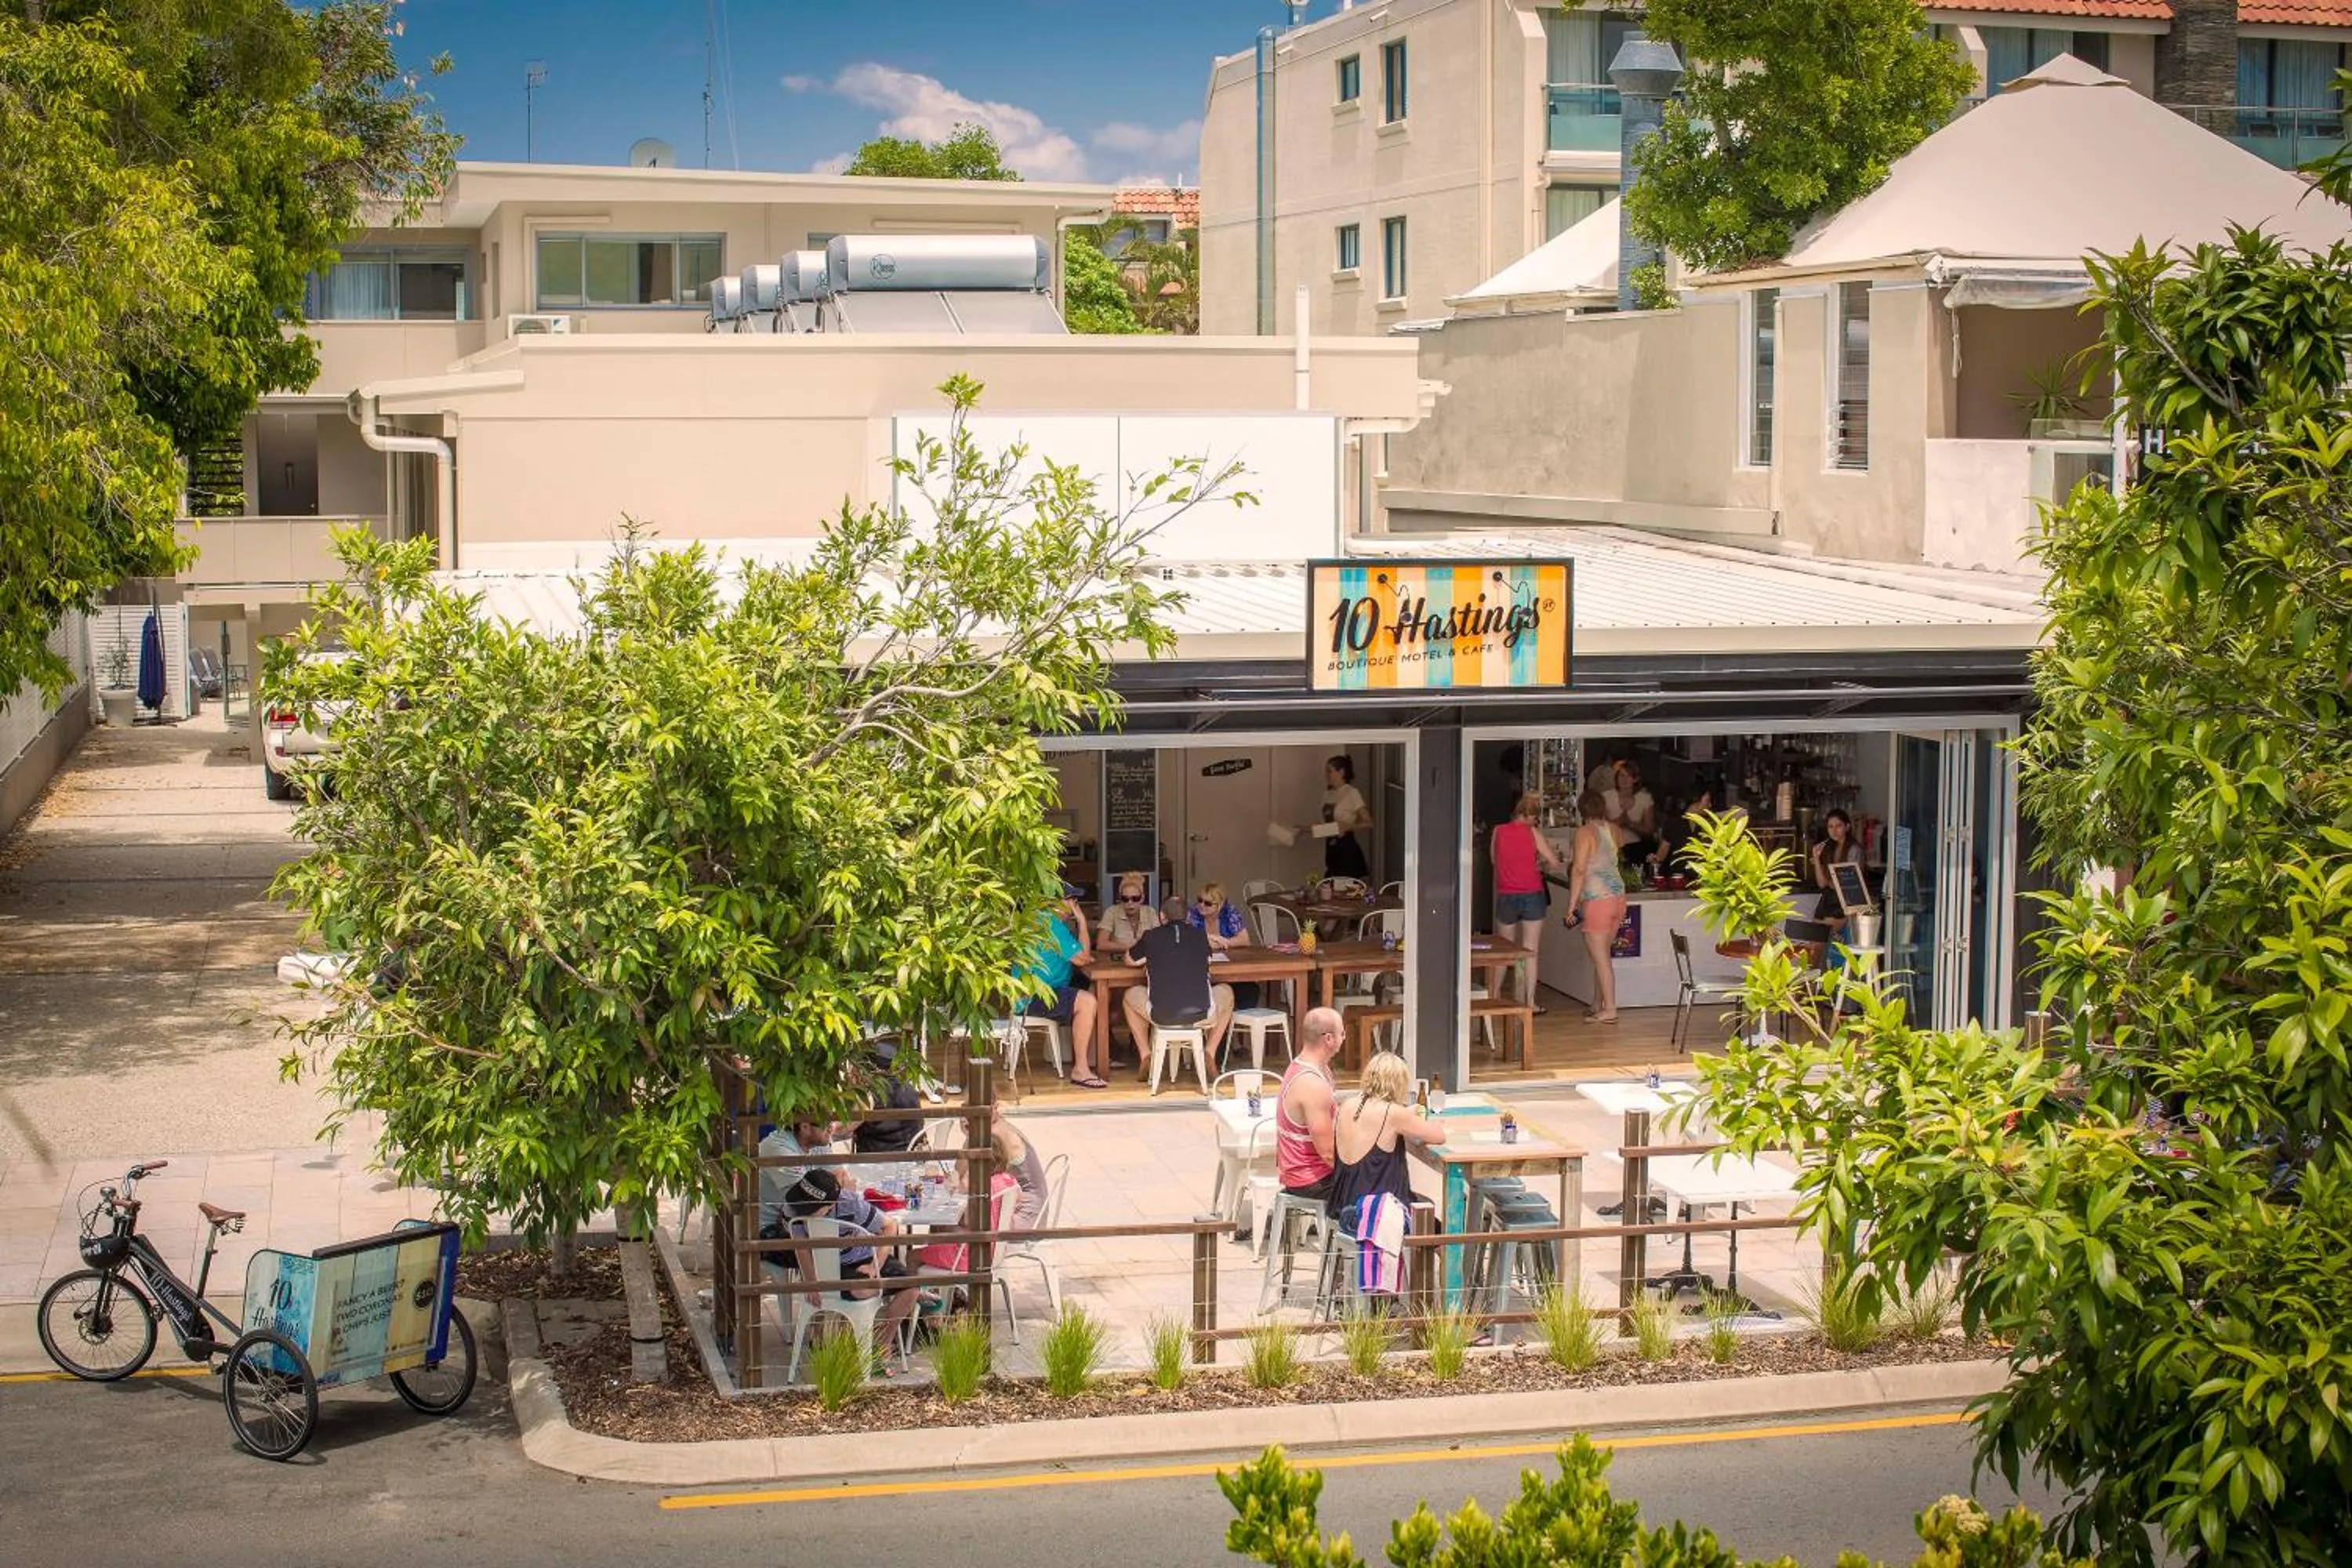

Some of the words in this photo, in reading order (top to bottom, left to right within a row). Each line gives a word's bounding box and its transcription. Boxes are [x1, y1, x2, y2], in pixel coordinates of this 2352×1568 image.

[1329, 597, 1381, 653] 10
[1384, 592, 1541, 649] Hastings
[1327, 655, 1395, 671] BOUTIQUE
[1401, 650, 1443, 663] MOTEL
[269, 1277, 292, 1311] 10
